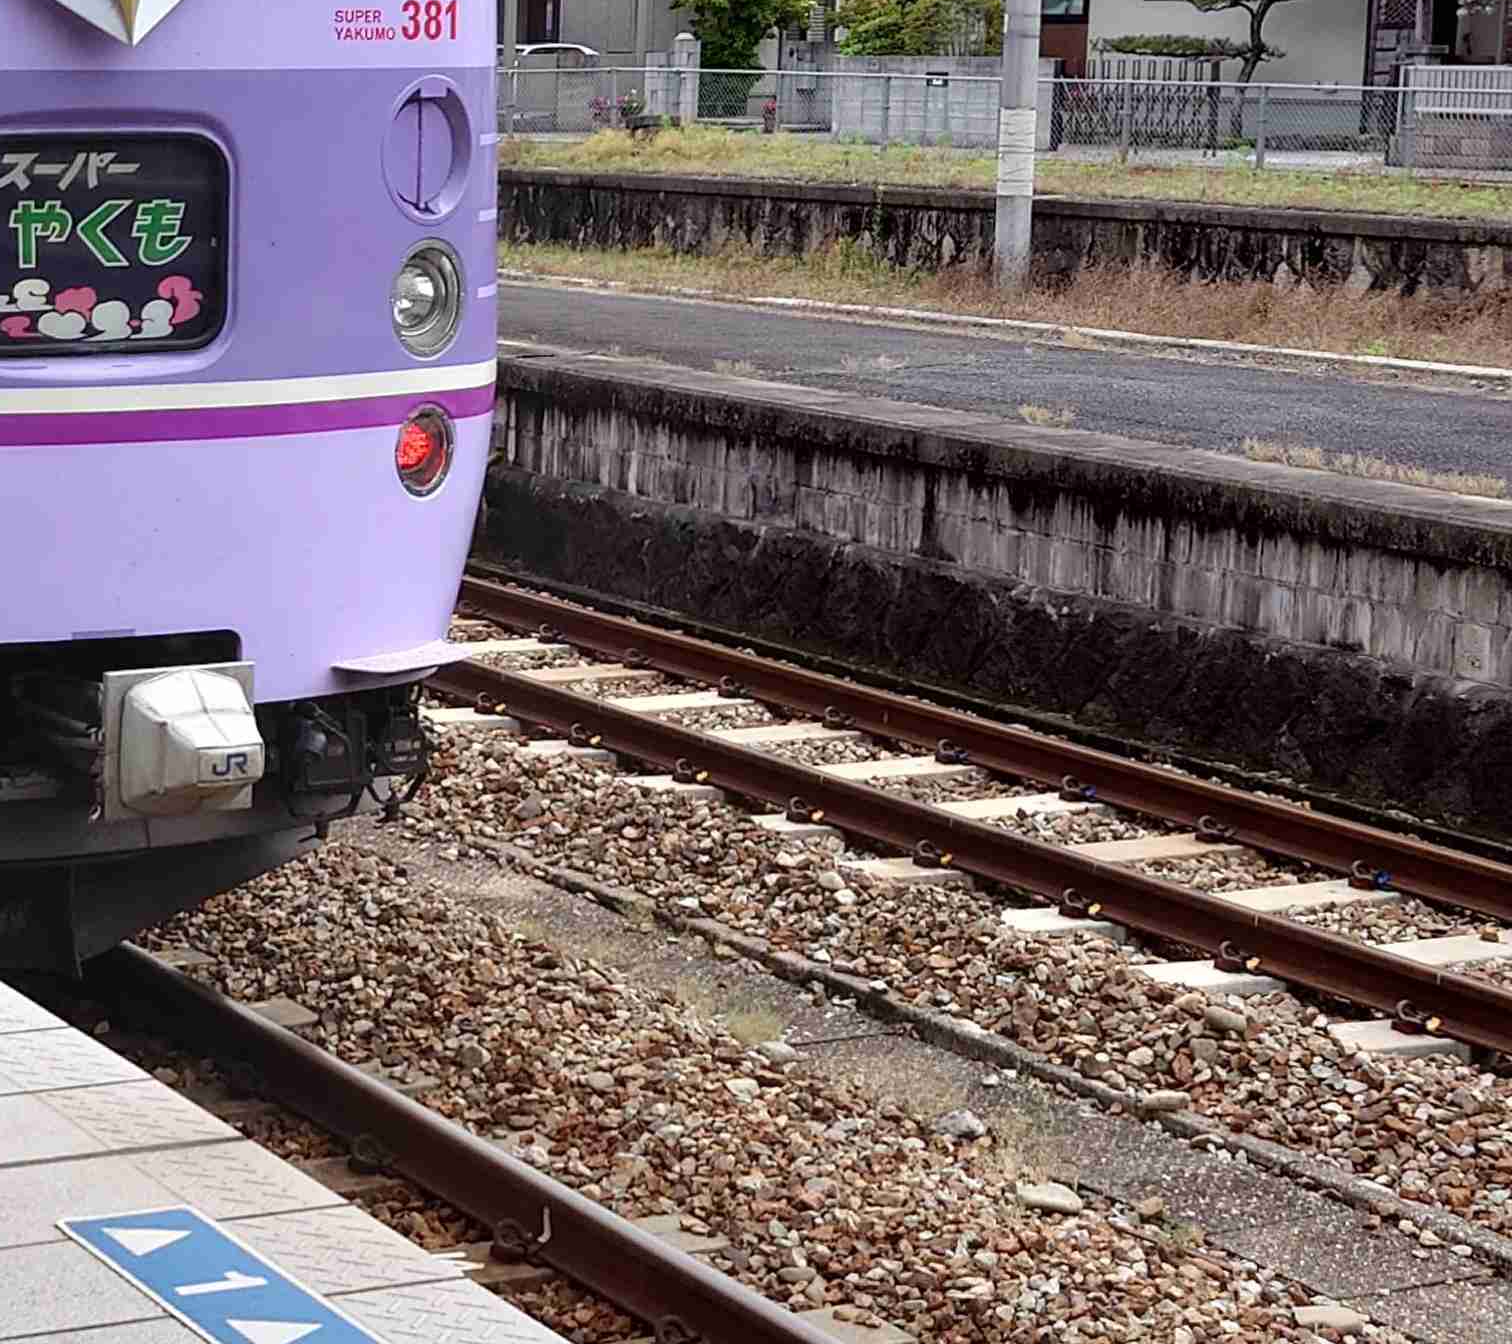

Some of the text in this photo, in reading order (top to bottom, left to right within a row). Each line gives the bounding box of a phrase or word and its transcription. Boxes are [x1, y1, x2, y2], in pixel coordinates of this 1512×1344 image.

[334, 0, 458, 41] SUPER 381
[334, 27, 396, 41] YAKUMO
[9, 199, 192, 270] やくも
[211, 753, 249, 777] JR
[175, 1270, 268, 1296] 1
